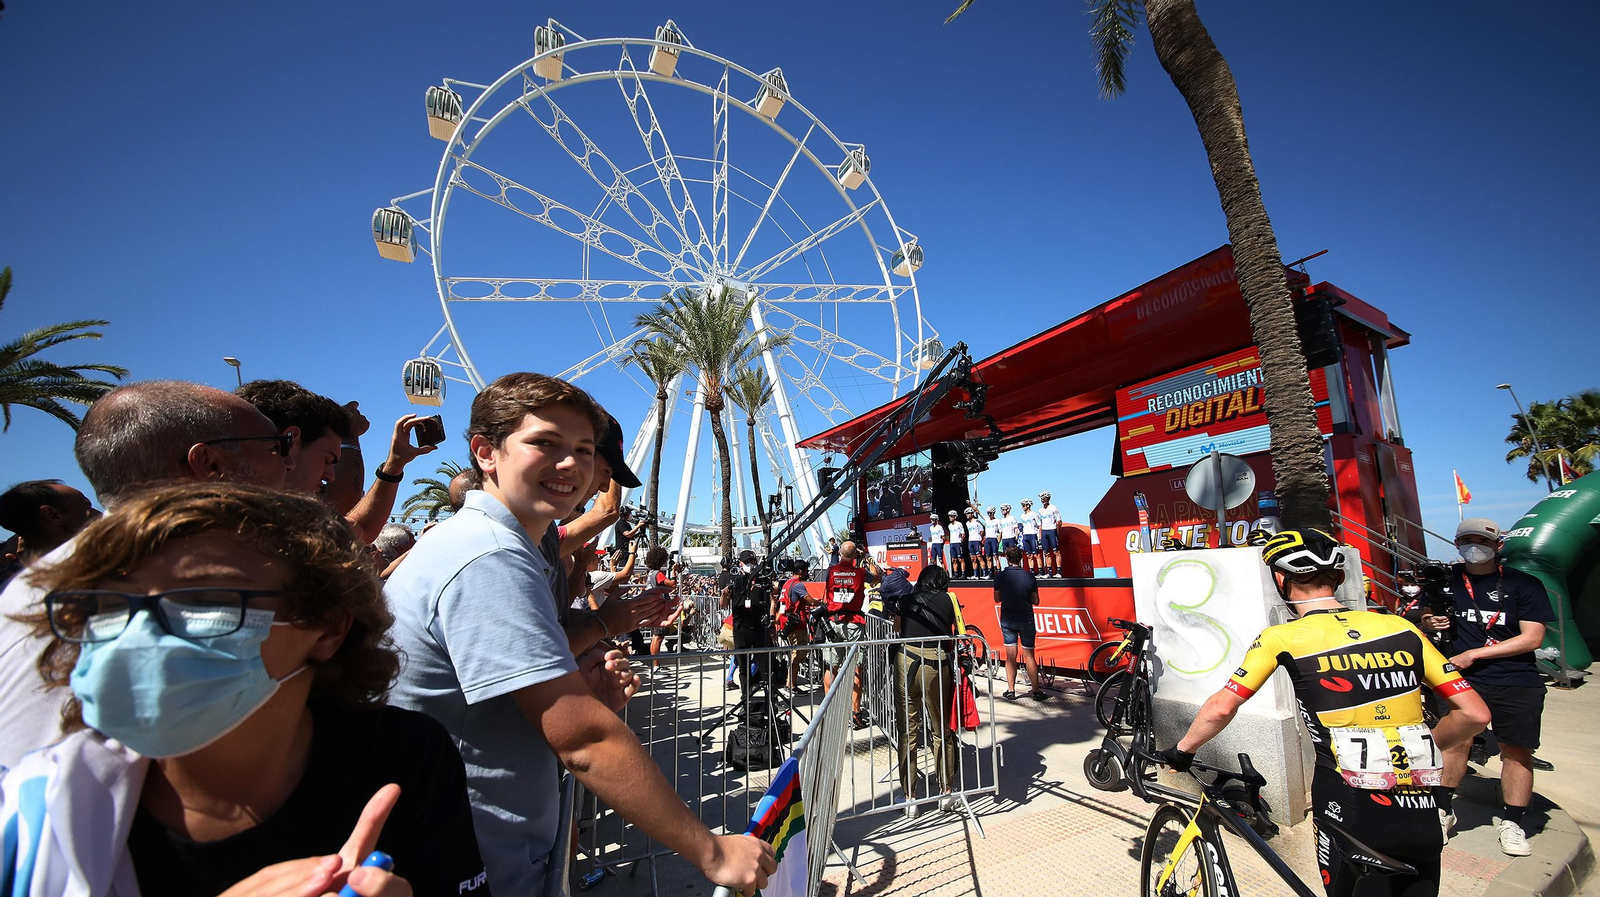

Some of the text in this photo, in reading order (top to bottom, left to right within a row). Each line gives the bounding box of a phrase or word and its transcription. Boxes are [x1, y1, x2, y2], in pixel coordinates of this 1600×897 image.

[1165, 387, 1261, 433] DIGITAL
[1178, 523, 1208, 548] TE
[1316, 650, 1415, 673] JUMBO
[1357, 670, 1418, 691] VISMA
[1350, 737, 1367, 770] 7
[1421, 734, 1436, 767] 7
[1394, 795, 1437, 809] VISMA
[1324, 809, 1344, 823] AGU
[1319, 829, 1331, 867] VISMA
